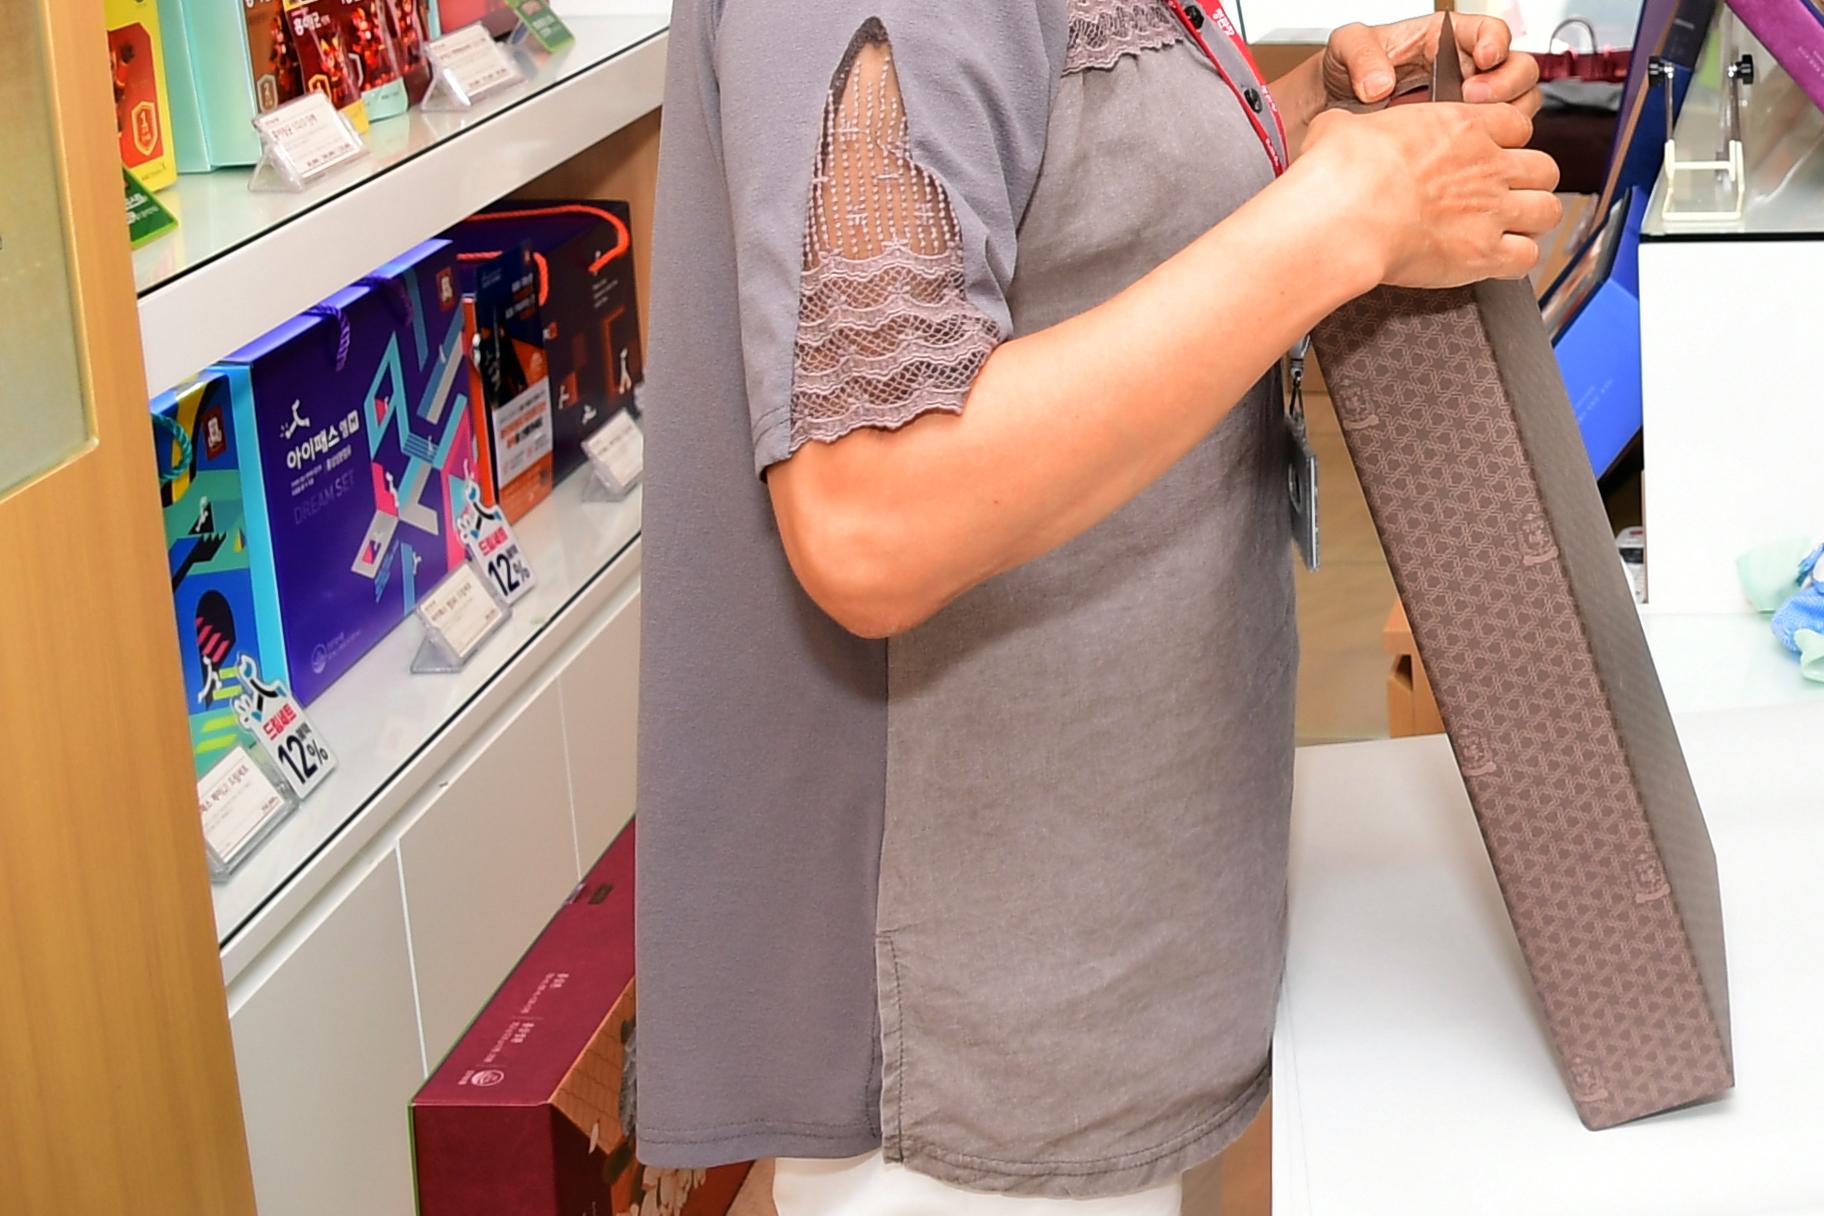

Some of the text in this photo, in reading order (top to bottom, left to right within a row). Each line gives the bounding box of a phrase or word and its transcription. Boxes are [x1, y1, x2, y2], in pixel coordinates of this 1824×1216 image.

[286, 425, 341, 471] 아이패스
[262, 702, 298, 742] 드림세트
[277, 734, 329, 785] 12%
